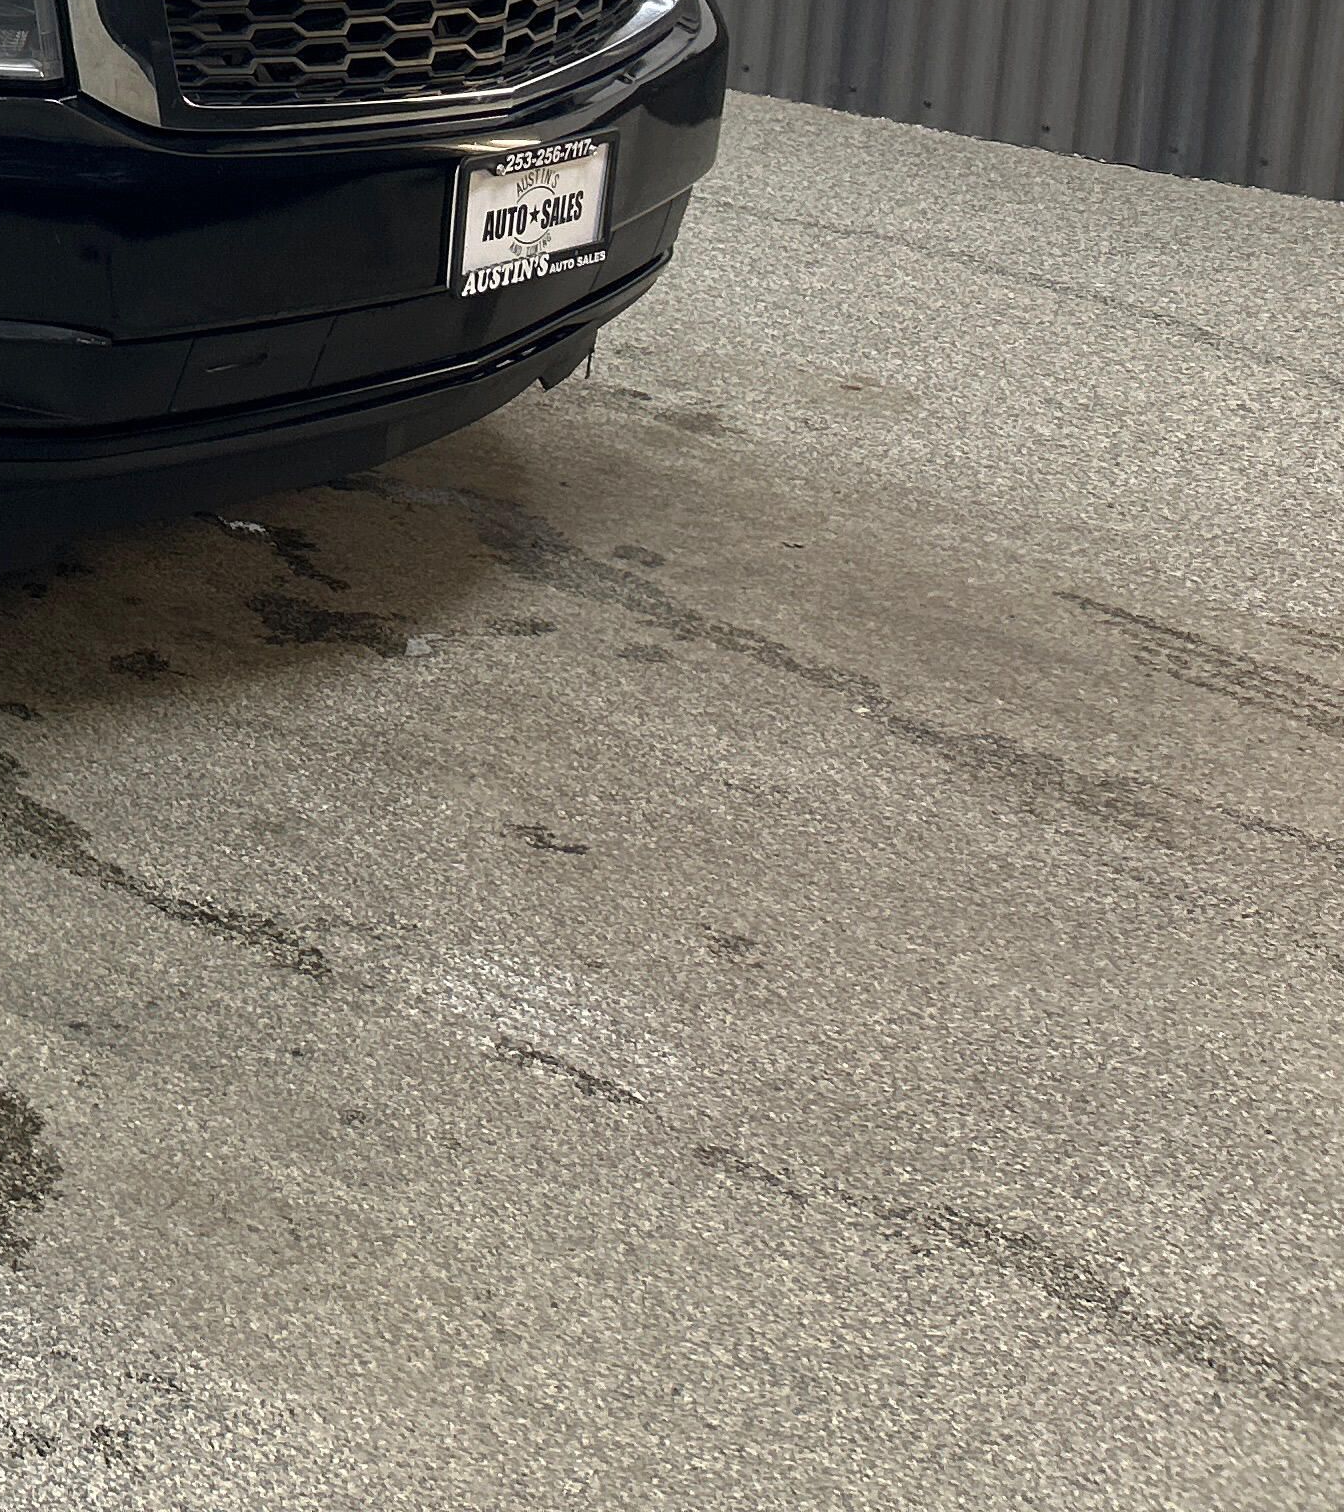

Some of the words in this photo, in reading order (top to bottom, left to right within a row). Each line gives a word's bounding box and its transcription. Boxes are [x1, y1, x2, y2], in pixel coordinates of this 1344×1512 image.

[505, 138, 592, 172] 253-256-7117
[516, 168, 560, 197] AUSTIN'S
[482, 204, 528, 242] AUTO
[540, 190, 584, 230] SALES
[461, 253, 550, 297] AUSTIN'S
[548, 258, 575, 274] AUTO
[577, 250, 606, 267] SALES
